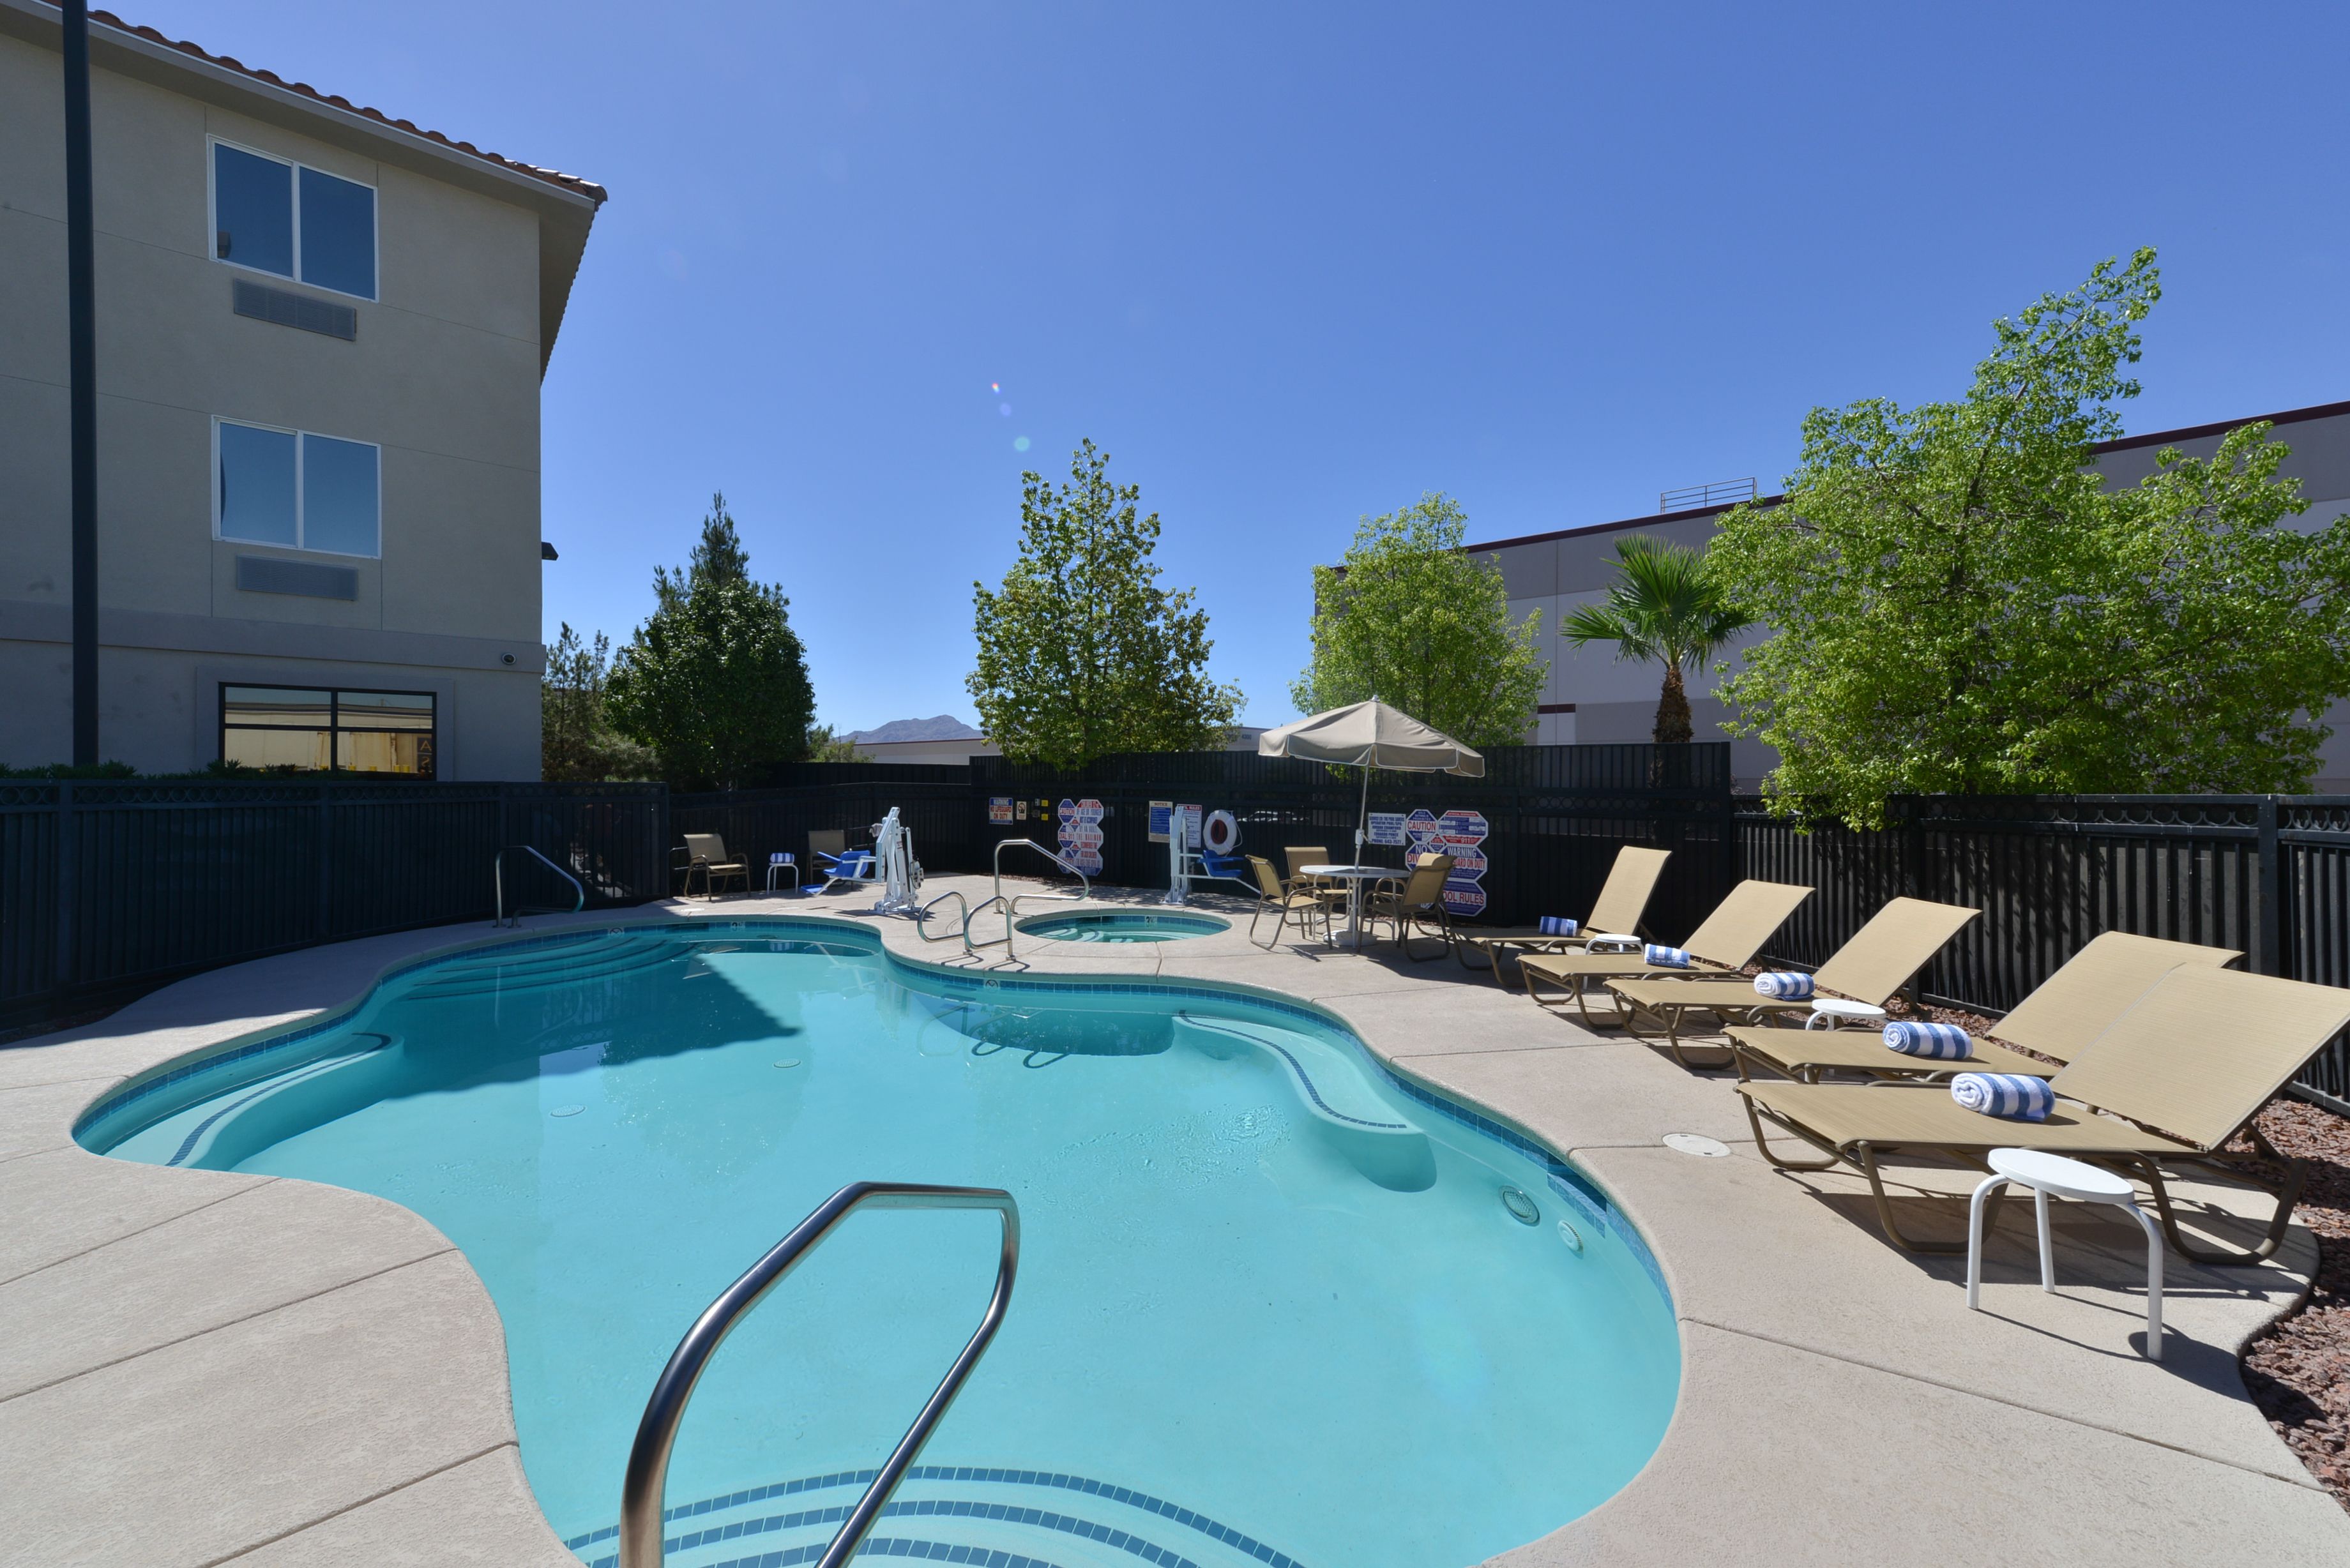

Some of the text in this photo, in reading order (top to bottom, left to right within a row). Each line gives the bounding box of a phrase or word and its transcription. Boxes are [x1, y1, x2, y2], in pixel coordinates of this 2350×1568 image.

[1407, 821, 1436, 831] CAUTION
[1085, 833, 1101, 841] MAXIMUM
[1415, 845, 1427, 854] NO
[1447, 847, 1477, 858] WARNING
[1407, 854, 1420, 863] DIV
[1467, 859, 1474, 868] ON
[1474, 859, 1485, 869] DUTY
[1443, 891, 1485, 905] OOL RULES
